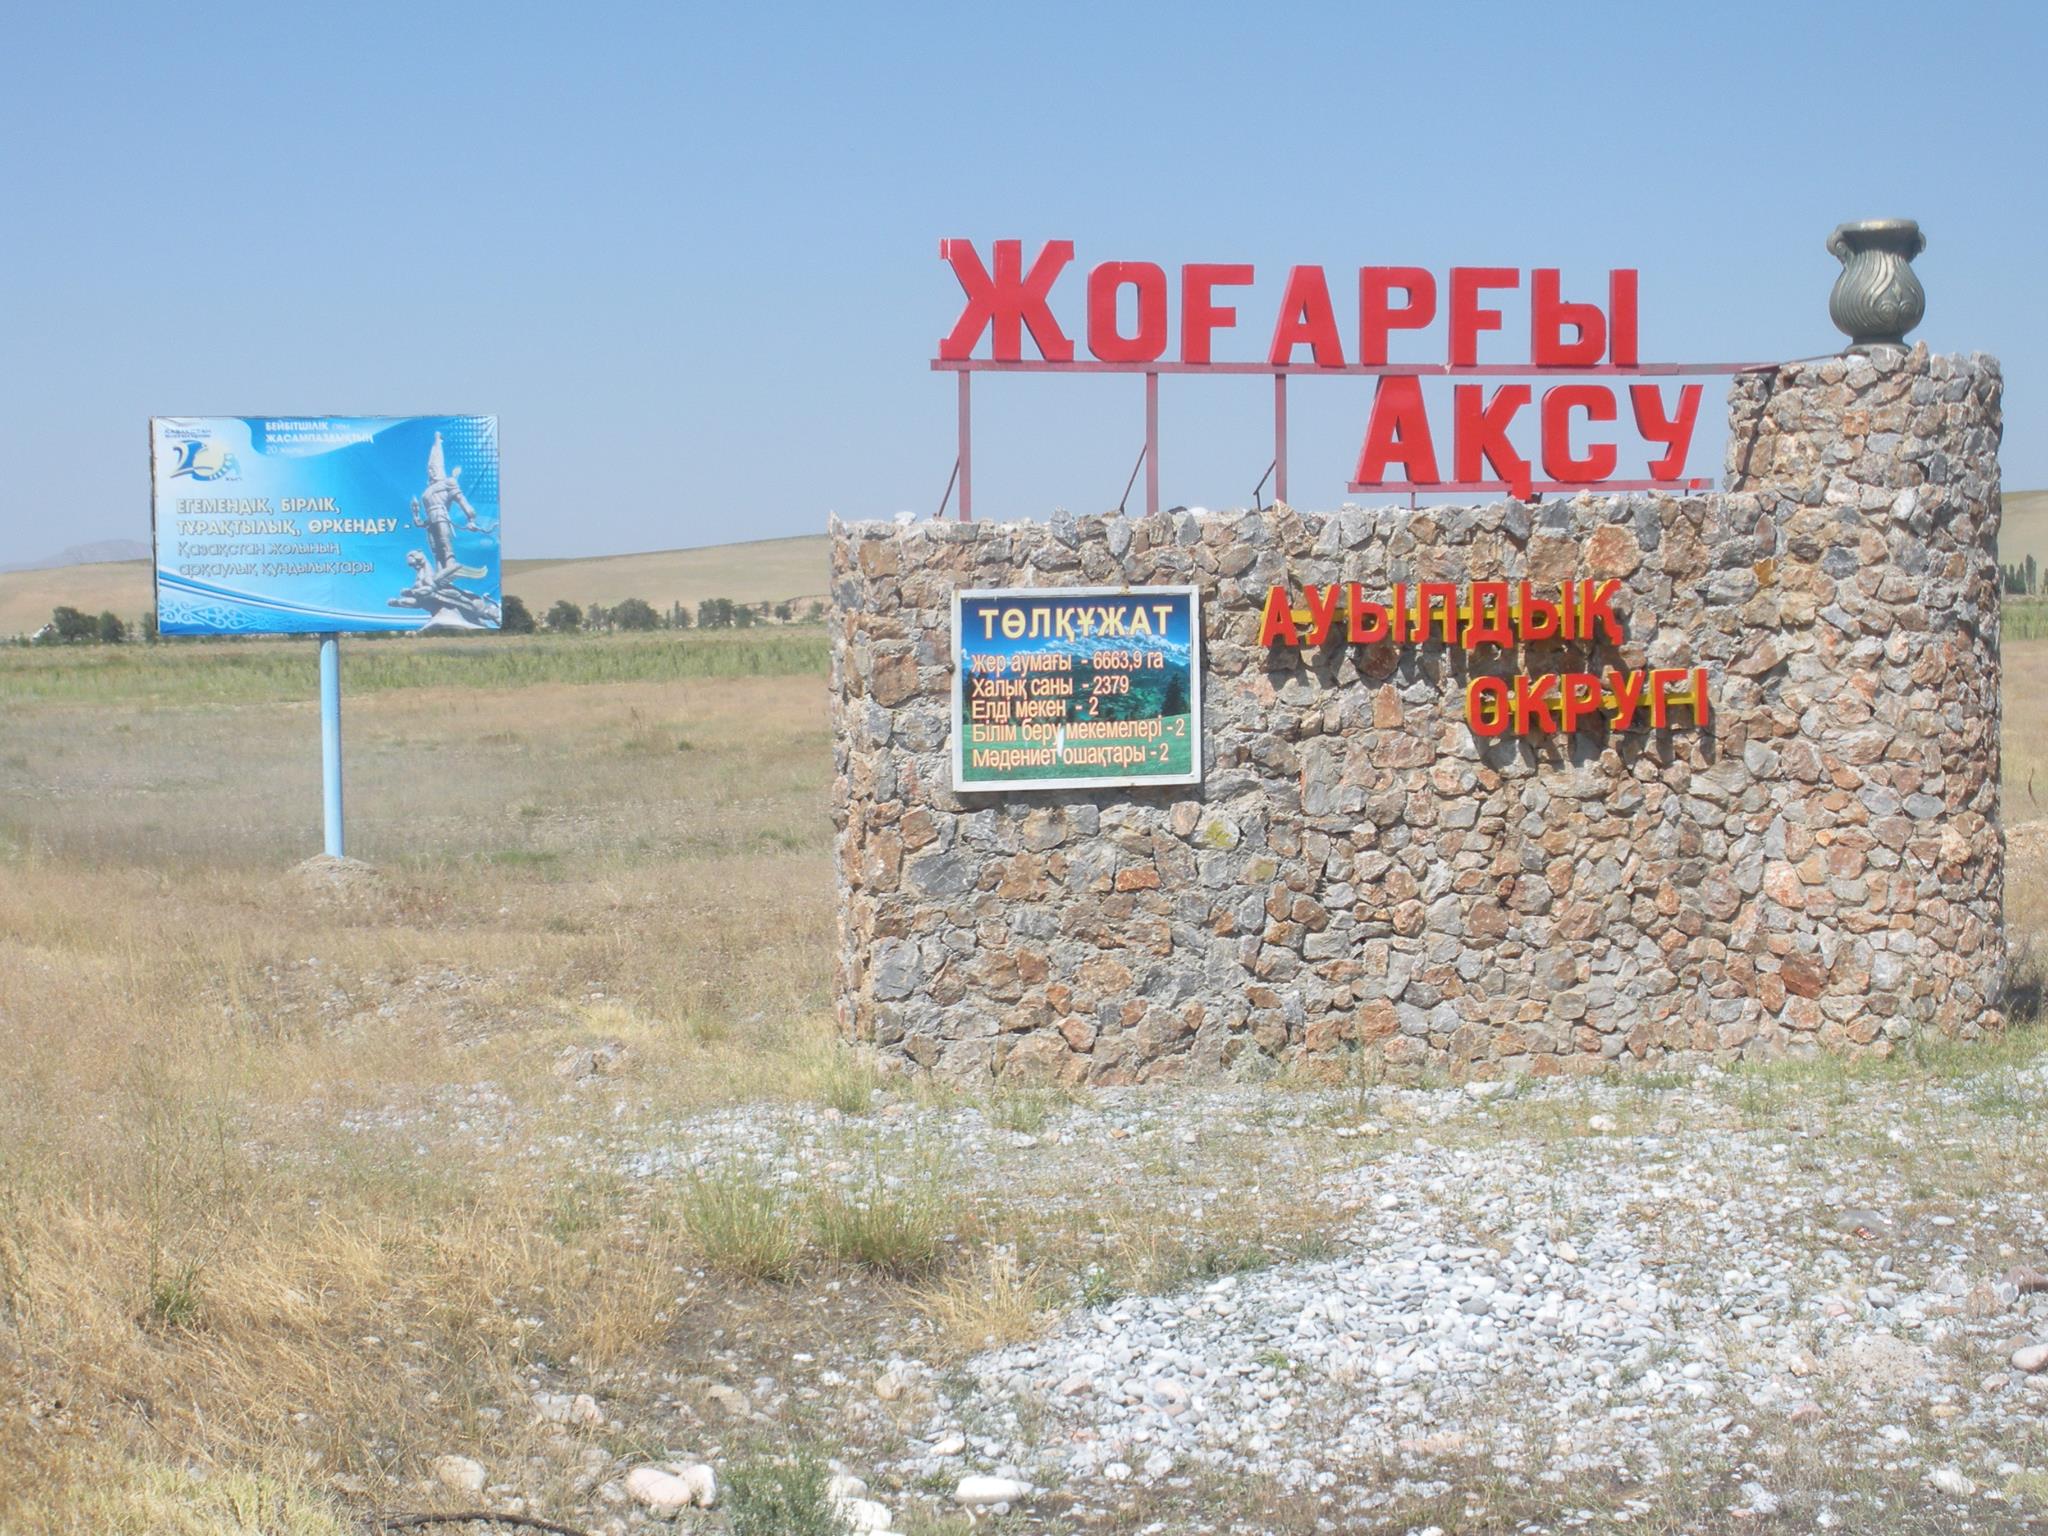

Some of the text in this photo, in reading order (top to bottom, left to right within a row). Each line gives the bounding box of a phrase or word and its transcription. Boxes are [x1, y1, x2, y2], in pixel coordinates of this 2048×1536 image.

[938, 237, 1640, 369] ЖОҒАРҒЫ
[1354, 375, 1704, 501] АҚСУ
[176, 497, 341, 515] ЕГЕМЕНДІК, БІРЛІК,
[177, 519, 301, 537] ТҰРАҚТЫЛЫҚ,
[308, 518, 397, 535] ӨРКЕНДЕУ
[178, 541, 341, 558] Қазақстан жолының
[979, 605, 1173, 641] ТӨЛҚҰЖАТ
[1259, 578, 1624, 650] АУЫЛДЫҚ
[1011, 653, 1072, 677] аумағы
[1093, 650, 1142, 672] 6663,9
[1147, 651, 1164, 669] га
[972, 677, 1027, 699] Халық
[1030, 678, 1073, 696] саны
[1093, 675, 1130, 694] 2379
[972, 696, 1012, 722] Елді
[1015, 699, 1067, 718] мекен
[1088, 696, 1099, 715] 2
[1467, 668, 1709, 736] ОКРУГІ
[973, 719, 1017, 742] Білім
[1021, 718, 1061, 746] беру
[1066, 714, 1162, 742] мекемелері
[973, 747, 1057, 771] Мәдениет
[1063, 745, 1146, 768] ошақтары
